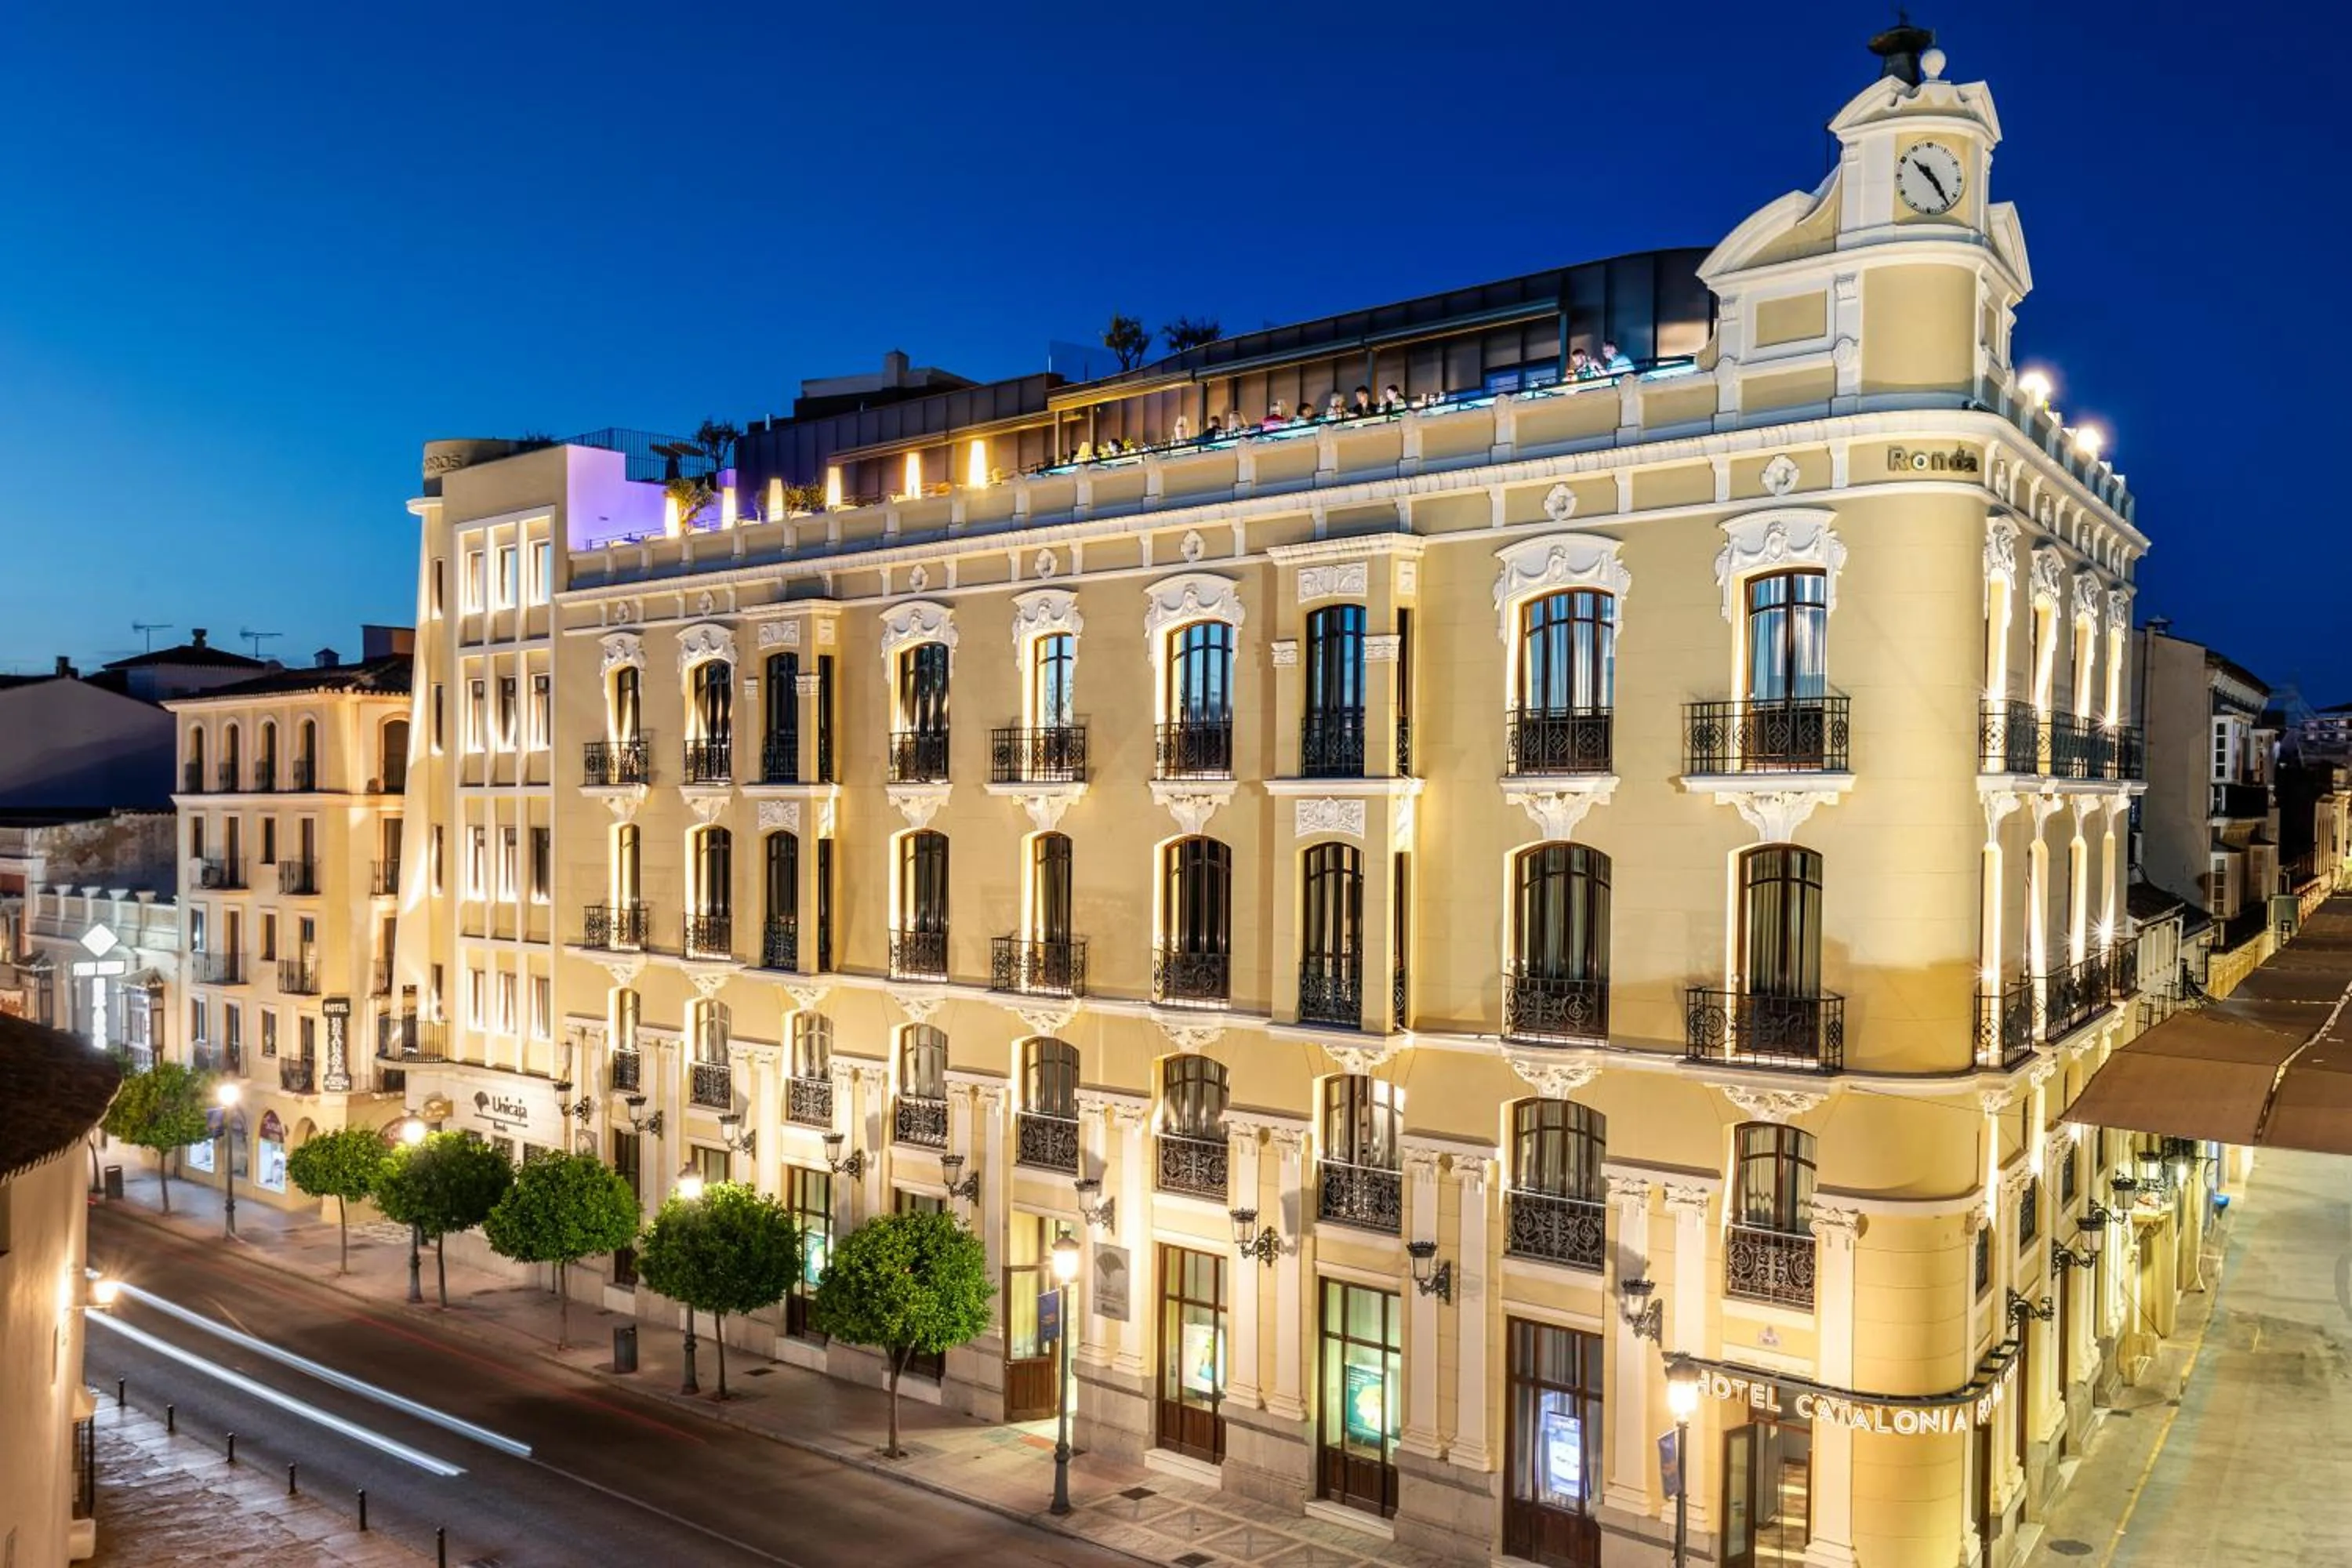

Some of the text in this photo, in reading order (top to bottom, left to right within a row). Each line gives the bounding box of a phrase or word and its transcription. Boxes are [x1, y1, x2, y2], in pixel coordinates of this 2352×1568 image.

[324, 1003, 348, 1013] HOTEL
[492, 1095, 528, 1123] Unicaja
[1697, 1369, 1782, 1413] HOTEL
[1796, 1392, 1967, 1435] CATALONIA
